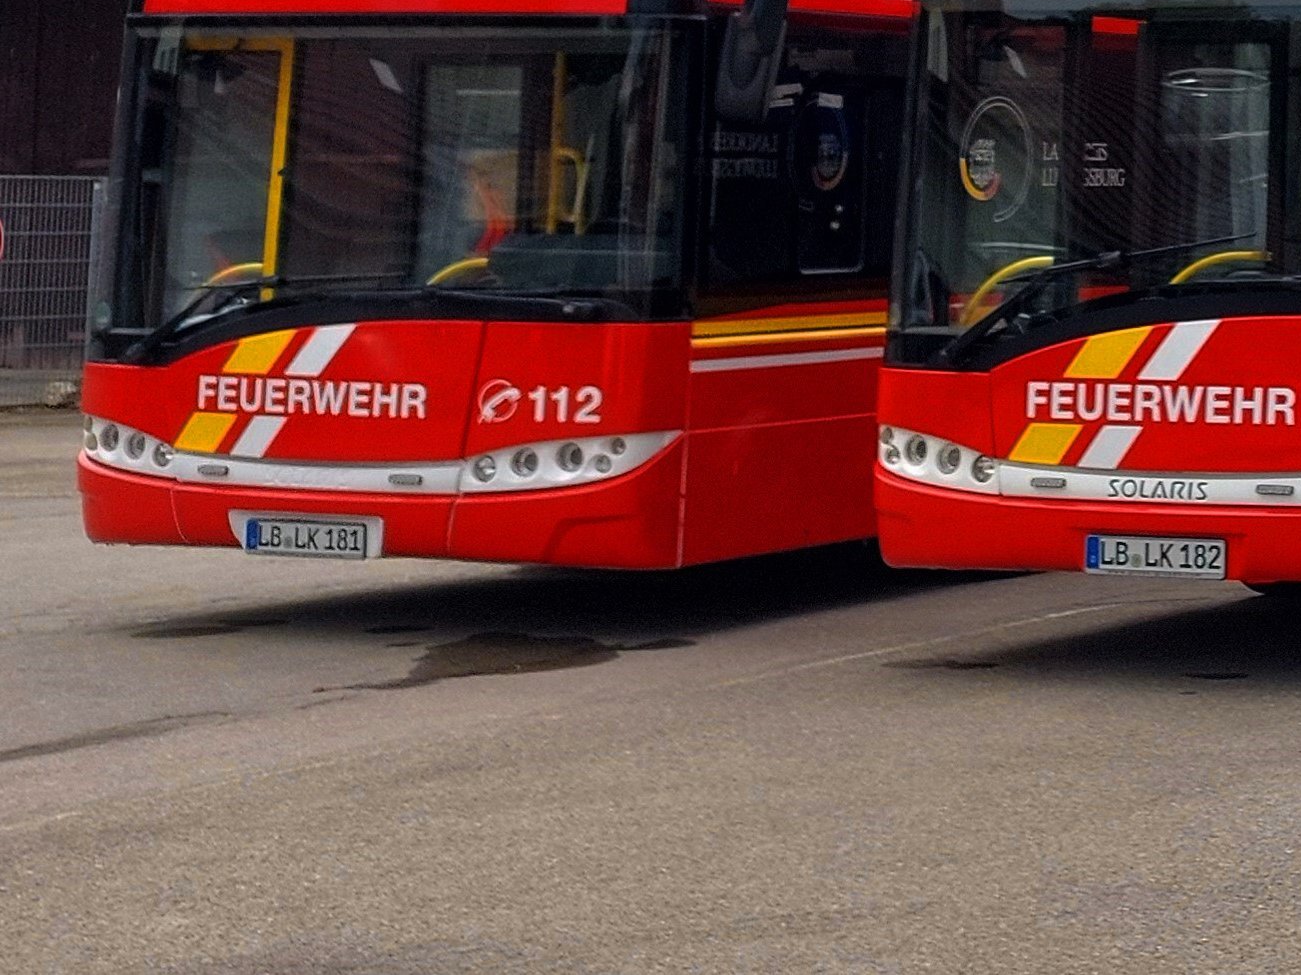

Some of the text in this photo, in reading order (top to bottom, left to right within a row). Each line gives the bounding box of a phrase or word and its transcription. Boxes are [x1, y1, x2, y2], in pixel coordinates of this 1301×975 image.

[198, 374, 428, 420] FEUERWEHR
[528, 385, 603, 423] 112
[1026, 381, 1296, 425] FEUERWEHR
[1108, 479, 1208, 500] SOLARIS
[258, 525, 361, 551] LB LK 181
[1100, 541, 1221, 570] LB LK 182
